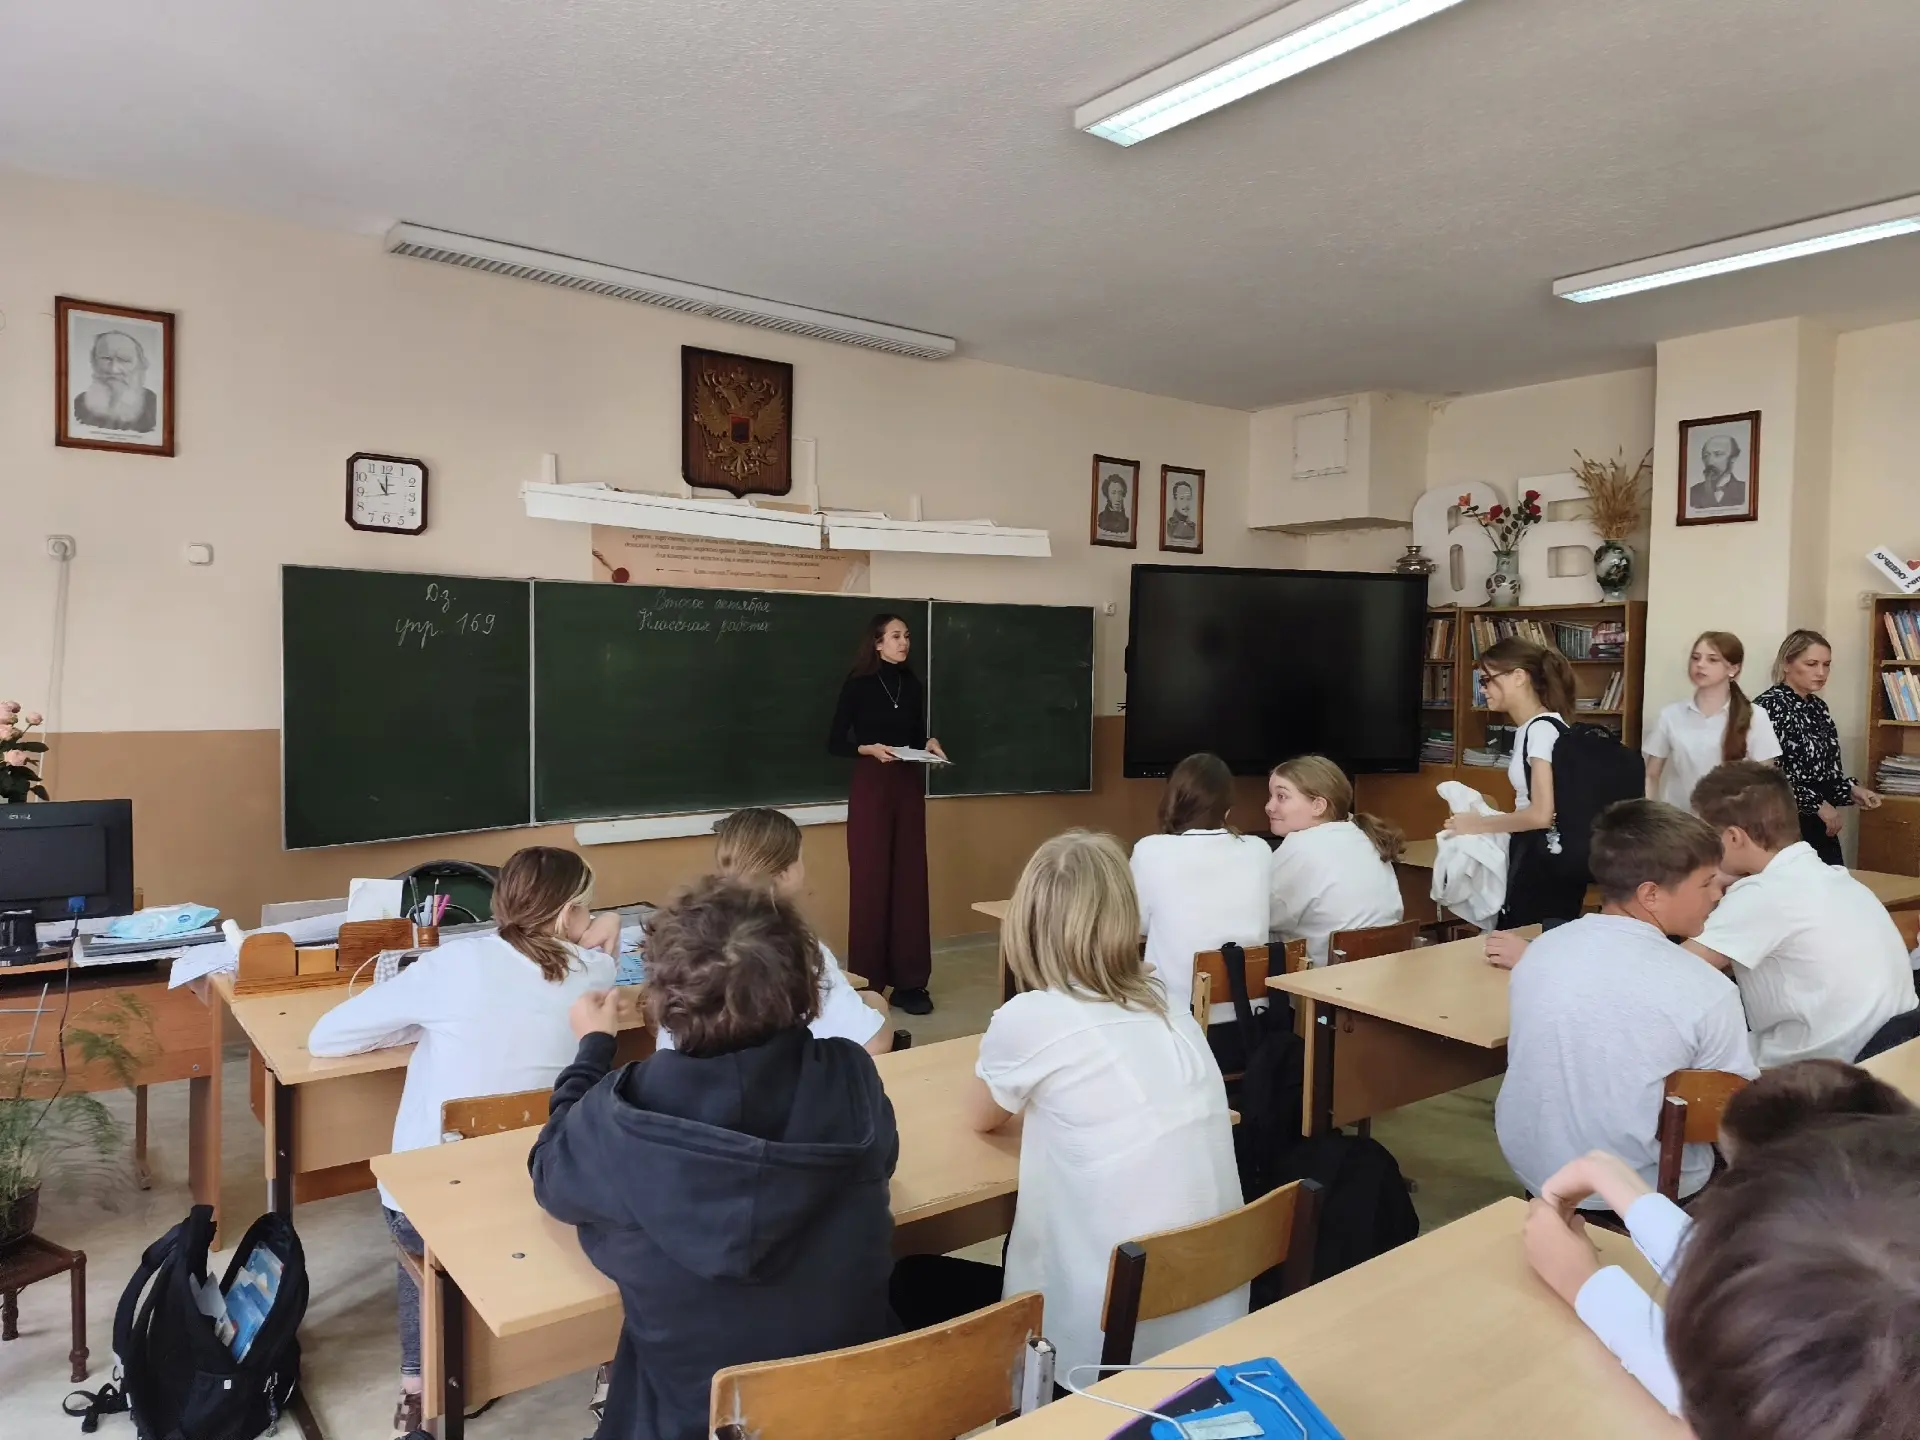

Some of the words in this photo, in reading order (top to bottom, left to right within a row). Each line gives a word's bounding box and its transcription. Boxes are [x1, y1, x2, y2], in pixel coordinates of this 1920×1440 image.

[381, 465, 393, 475] 12
[356, 472, 367, 482] 10
[409, 478, 416, 488] 2
[357, 487, 364, 497] 9
[409, 493, 415, 502] 3
[357, 502, 364, 511] 8
[382, 514, 391, 524] 6
[457, 613, 496, 634] 169
[637, 608, 711, 632] Классная
[714, 615, 771, 645] работа
